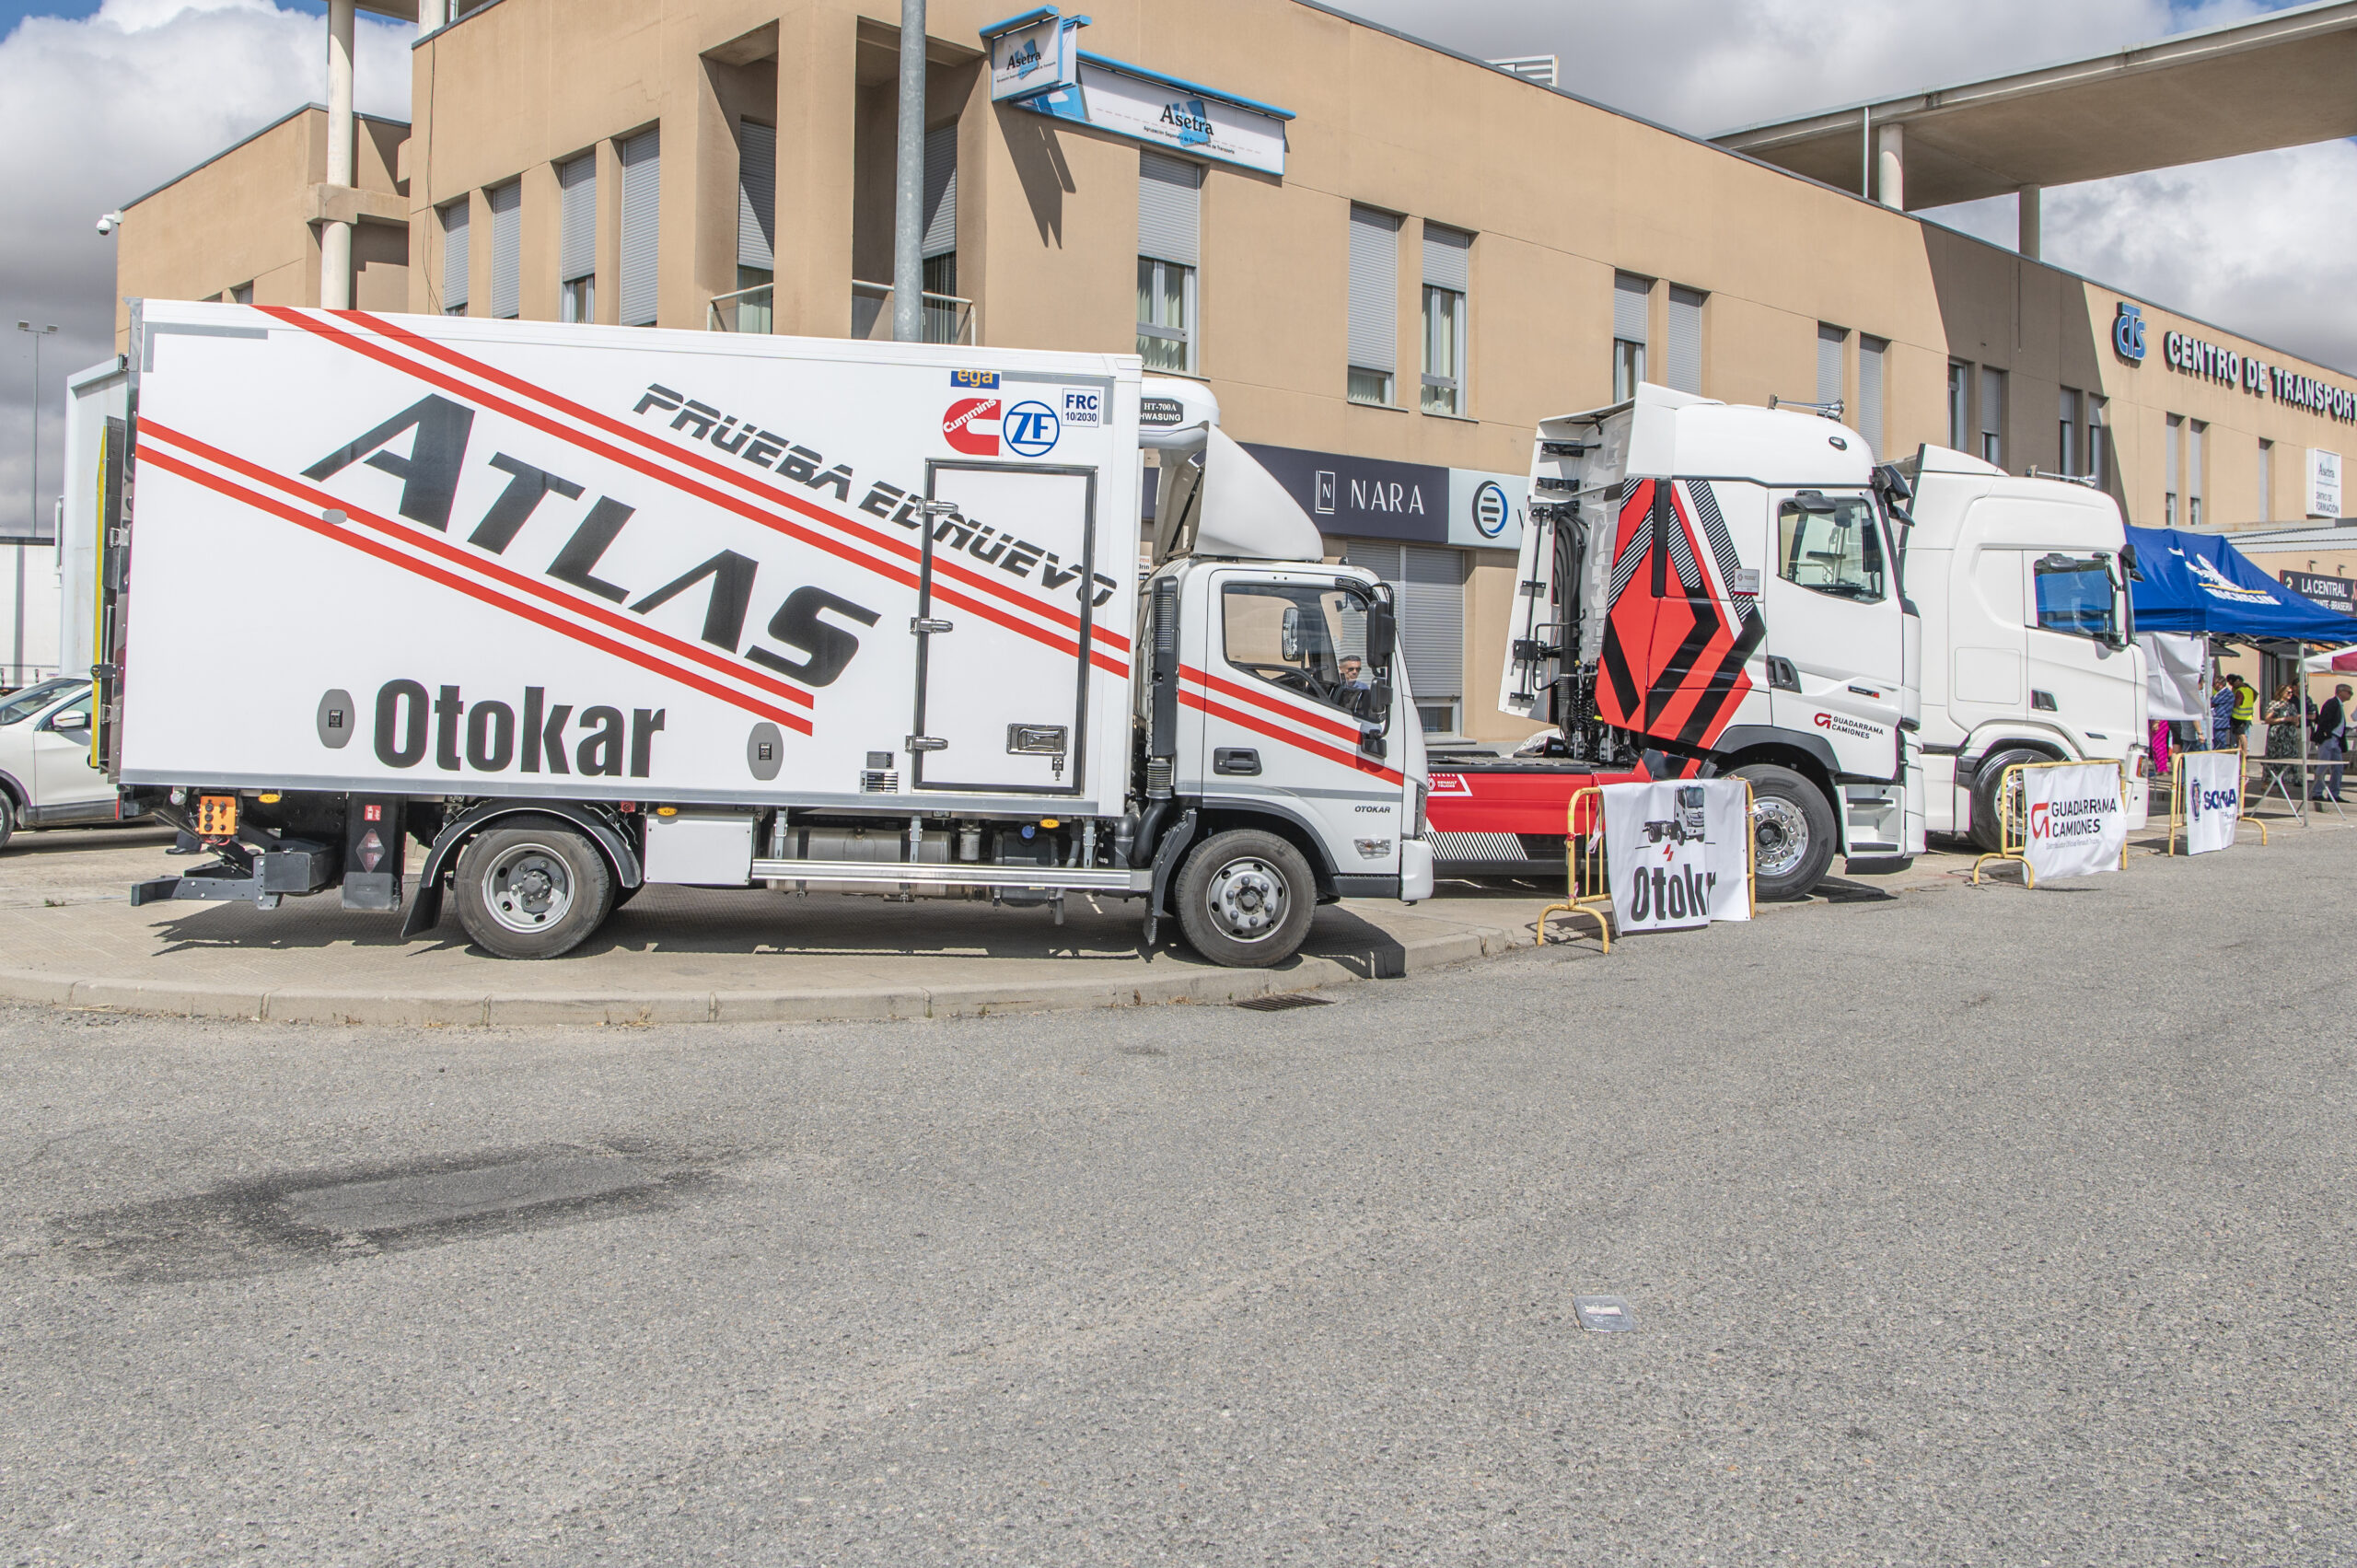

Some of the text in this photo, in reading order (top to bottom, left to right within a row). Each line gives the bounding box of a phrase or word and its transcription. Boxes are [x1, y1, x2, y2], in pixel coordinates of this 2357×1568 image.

[1006, 52, 1041, 70] Asetra
[1159, 104, 1214, 135] Asetra
[2166, 331, 2240, 383] CENTRO
[2244, 356, 2268, 392] DE
[958, 368, 993, 387] ega
[1065, 394, 1097, 410] FRC
[1144, 402, 1177, 412] HT-700A
[943, 398, 997, 434] Cummins
[1065, 412, 1097, 423] 10/2030
[1140, 412, 1181, 422] HWASUNG
[1009, 412, 1057, 447] ZF
[2318, 462, 2335, 479] Asetra
[633, 383, 1117, 608] PRUEBA EL NUEVO
[1322, 479, 1424, 516] N NARA
[299, 392, 881, 687] ATLAS
[2302, 577, 2348, 598] LA CENTRAL
[374, 678, 666, 779] Otokar
[1831, 724, 1870, 739] CAMIONES
[1833, 715, 1884, 736] GUADARRAMA
[1354, 805, 1391, 813] OTOKAR
[2051, 797, 2117, 818] GUADARRAMA
[2052, 818, 2101, 838] CAMIONES
